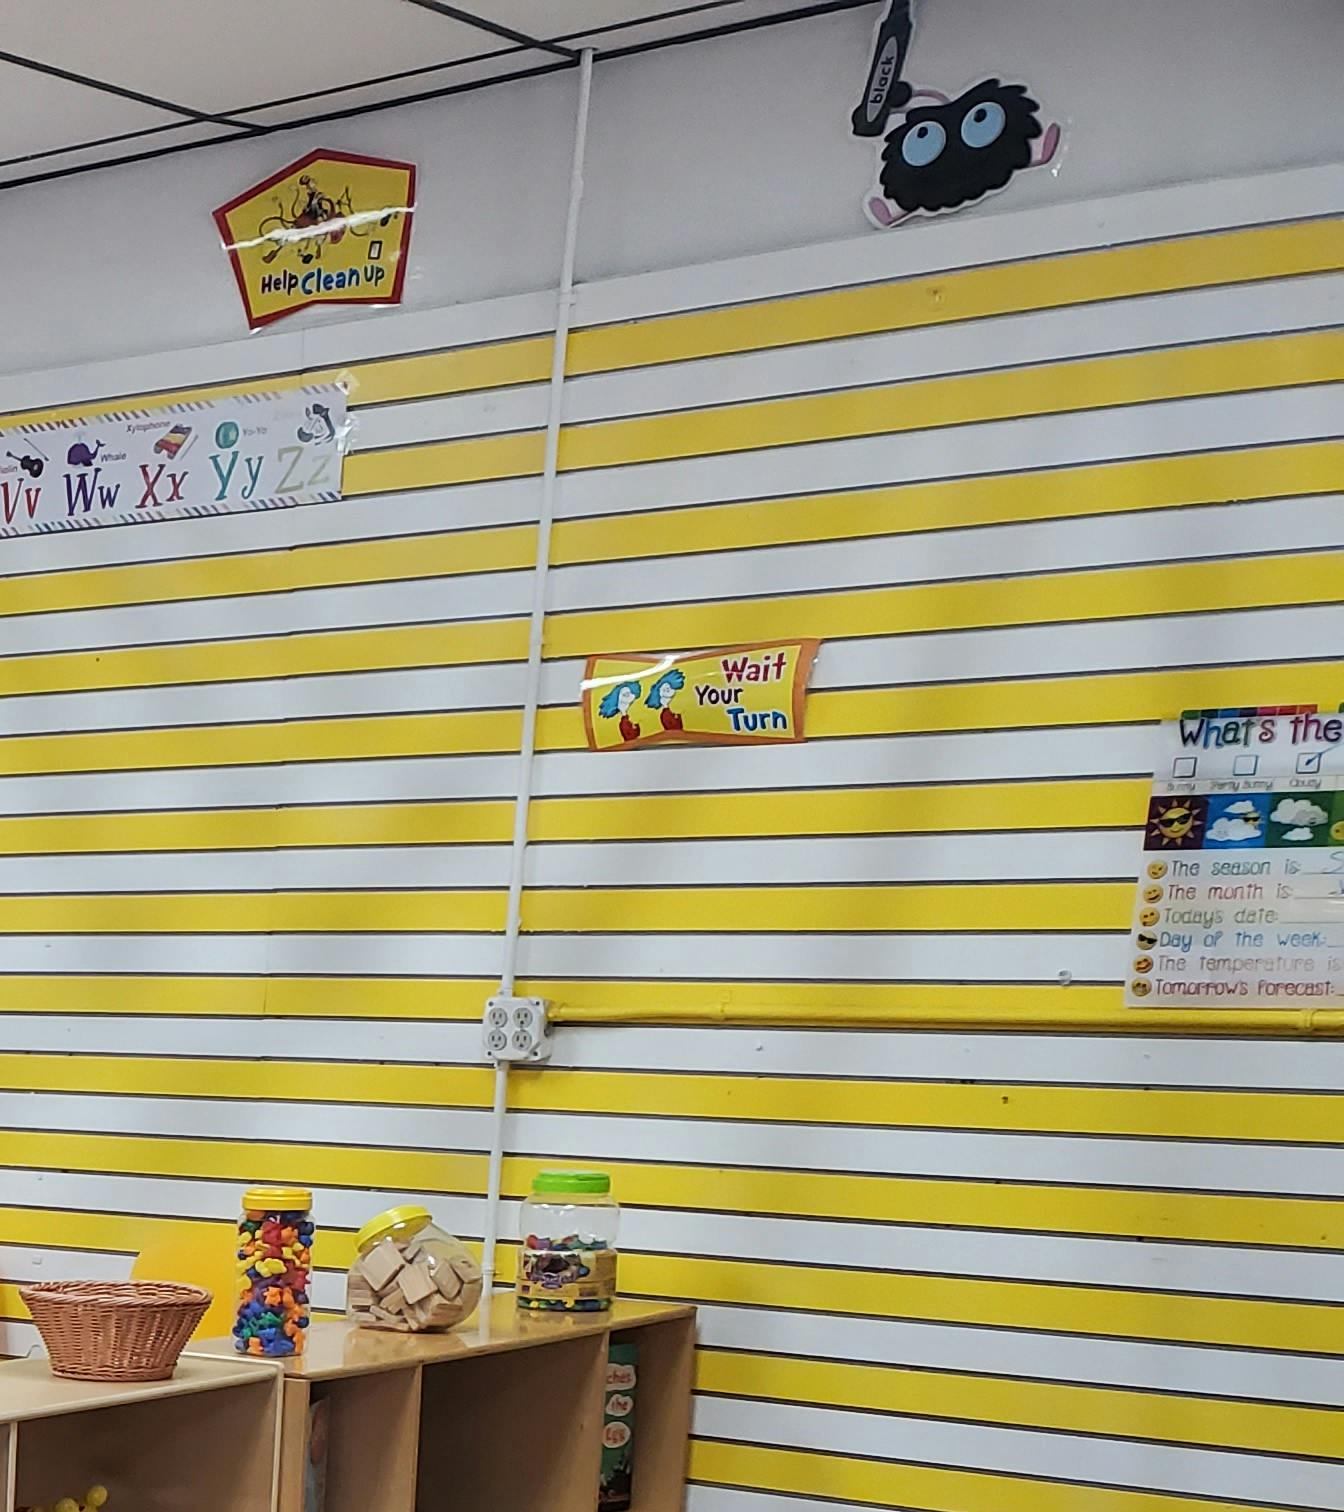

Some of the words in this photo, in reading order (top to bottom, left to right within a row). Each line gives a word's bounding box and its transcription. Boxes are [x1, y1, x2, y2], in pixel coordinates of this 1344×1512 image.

[871, 55, 896, 105] black
[261, 269, 299, 295] Help
[301, 267, 360, 295] Clean
[126, 420, 171, 434] Xylophone
[100, 452, 127, 462] Whale
[0, 478, 42, 525] Vv
[62, 467, 120, 517] Ww
[135, 463, 189, 510] Xx
[209, 450, 264, 502] Yy
[273, 445, 332, 494] Zz
[722, 652, 787, 683] Wait
[695, 685, 743, 705] Your
[727, 708, 787, 732] Turn
[1290, 713, 1343, 745] the
[1171, 860, 1200, 876] The
[1211, 861, 1271, 876] season
[1168, 884, 1197, 900] The
[1208, 884, 1263, 900] month
[1159, 932, 1193, 953] Day
[1203, 931, 1223, 948] of
[1236, 931, 1264, 948] the
[1277, 932, 1328, 948] week:
[1158, 955, 1187, 971] The
[1200, 955, 1315, 973] temperature
[1258, 979, 1334, 996] forecast:
